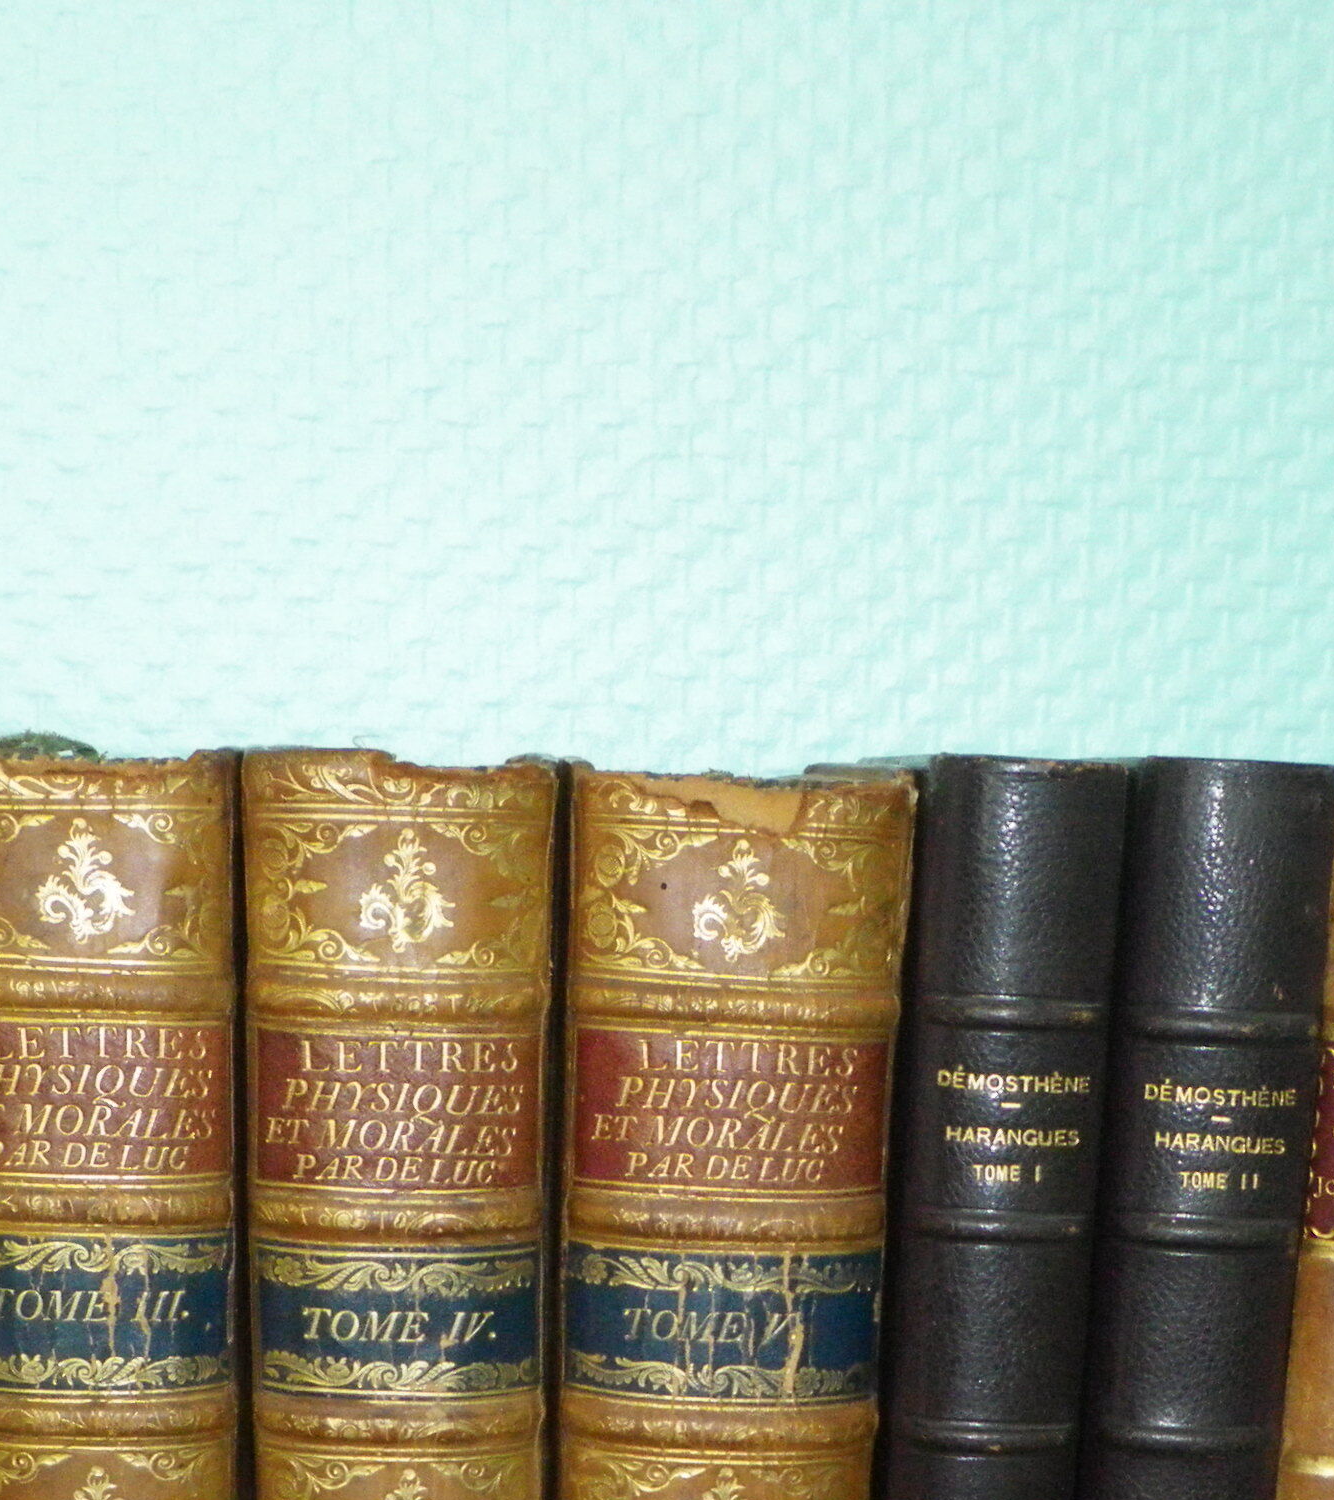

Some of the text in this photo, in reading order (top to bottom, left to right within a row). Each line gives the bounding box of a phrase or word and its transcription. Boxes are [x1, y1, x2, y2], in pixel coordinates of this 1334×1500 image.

[299, 1039, 521, 1073] LETTRES
[638, 1039, 859, 1077] LETTRES
[937, 1064, 1092, 1094] DÉMOSTHÈNE
[1144, 1077, 1297, 1107] DÉMOSTHÈNE
[283, 1079, 525, 1125] PHYSIQUES
[615, 1076, 858, 1123] PHYSIQUES
[16, 1103, 215, 1141] MORALES
[266, 1118, 518, 1158] ET MORALES
[591, 1115, 845, 1155] ET MORALES
[945, 1125, 1080, 1147] HARANGUES
[63, 1141, 112, 1168] DE
[121, 1144, 190, 1171] LUC
[1154, 1131, 1286, 1155] HARANGUES
[294, 1153, 498, 1185] PAR DE LUC
[626, 1152, 825, 1182] PAR DE LUC
[972, 1164, 1041, 1183] TOME I
[1179, 1171, 1259, 1191] TOME II
[133, 1289, 191, 1322] III.
[302, 1308, 498, 1343] TOME IV.
[623, 1308, 748, 1344] TOME
